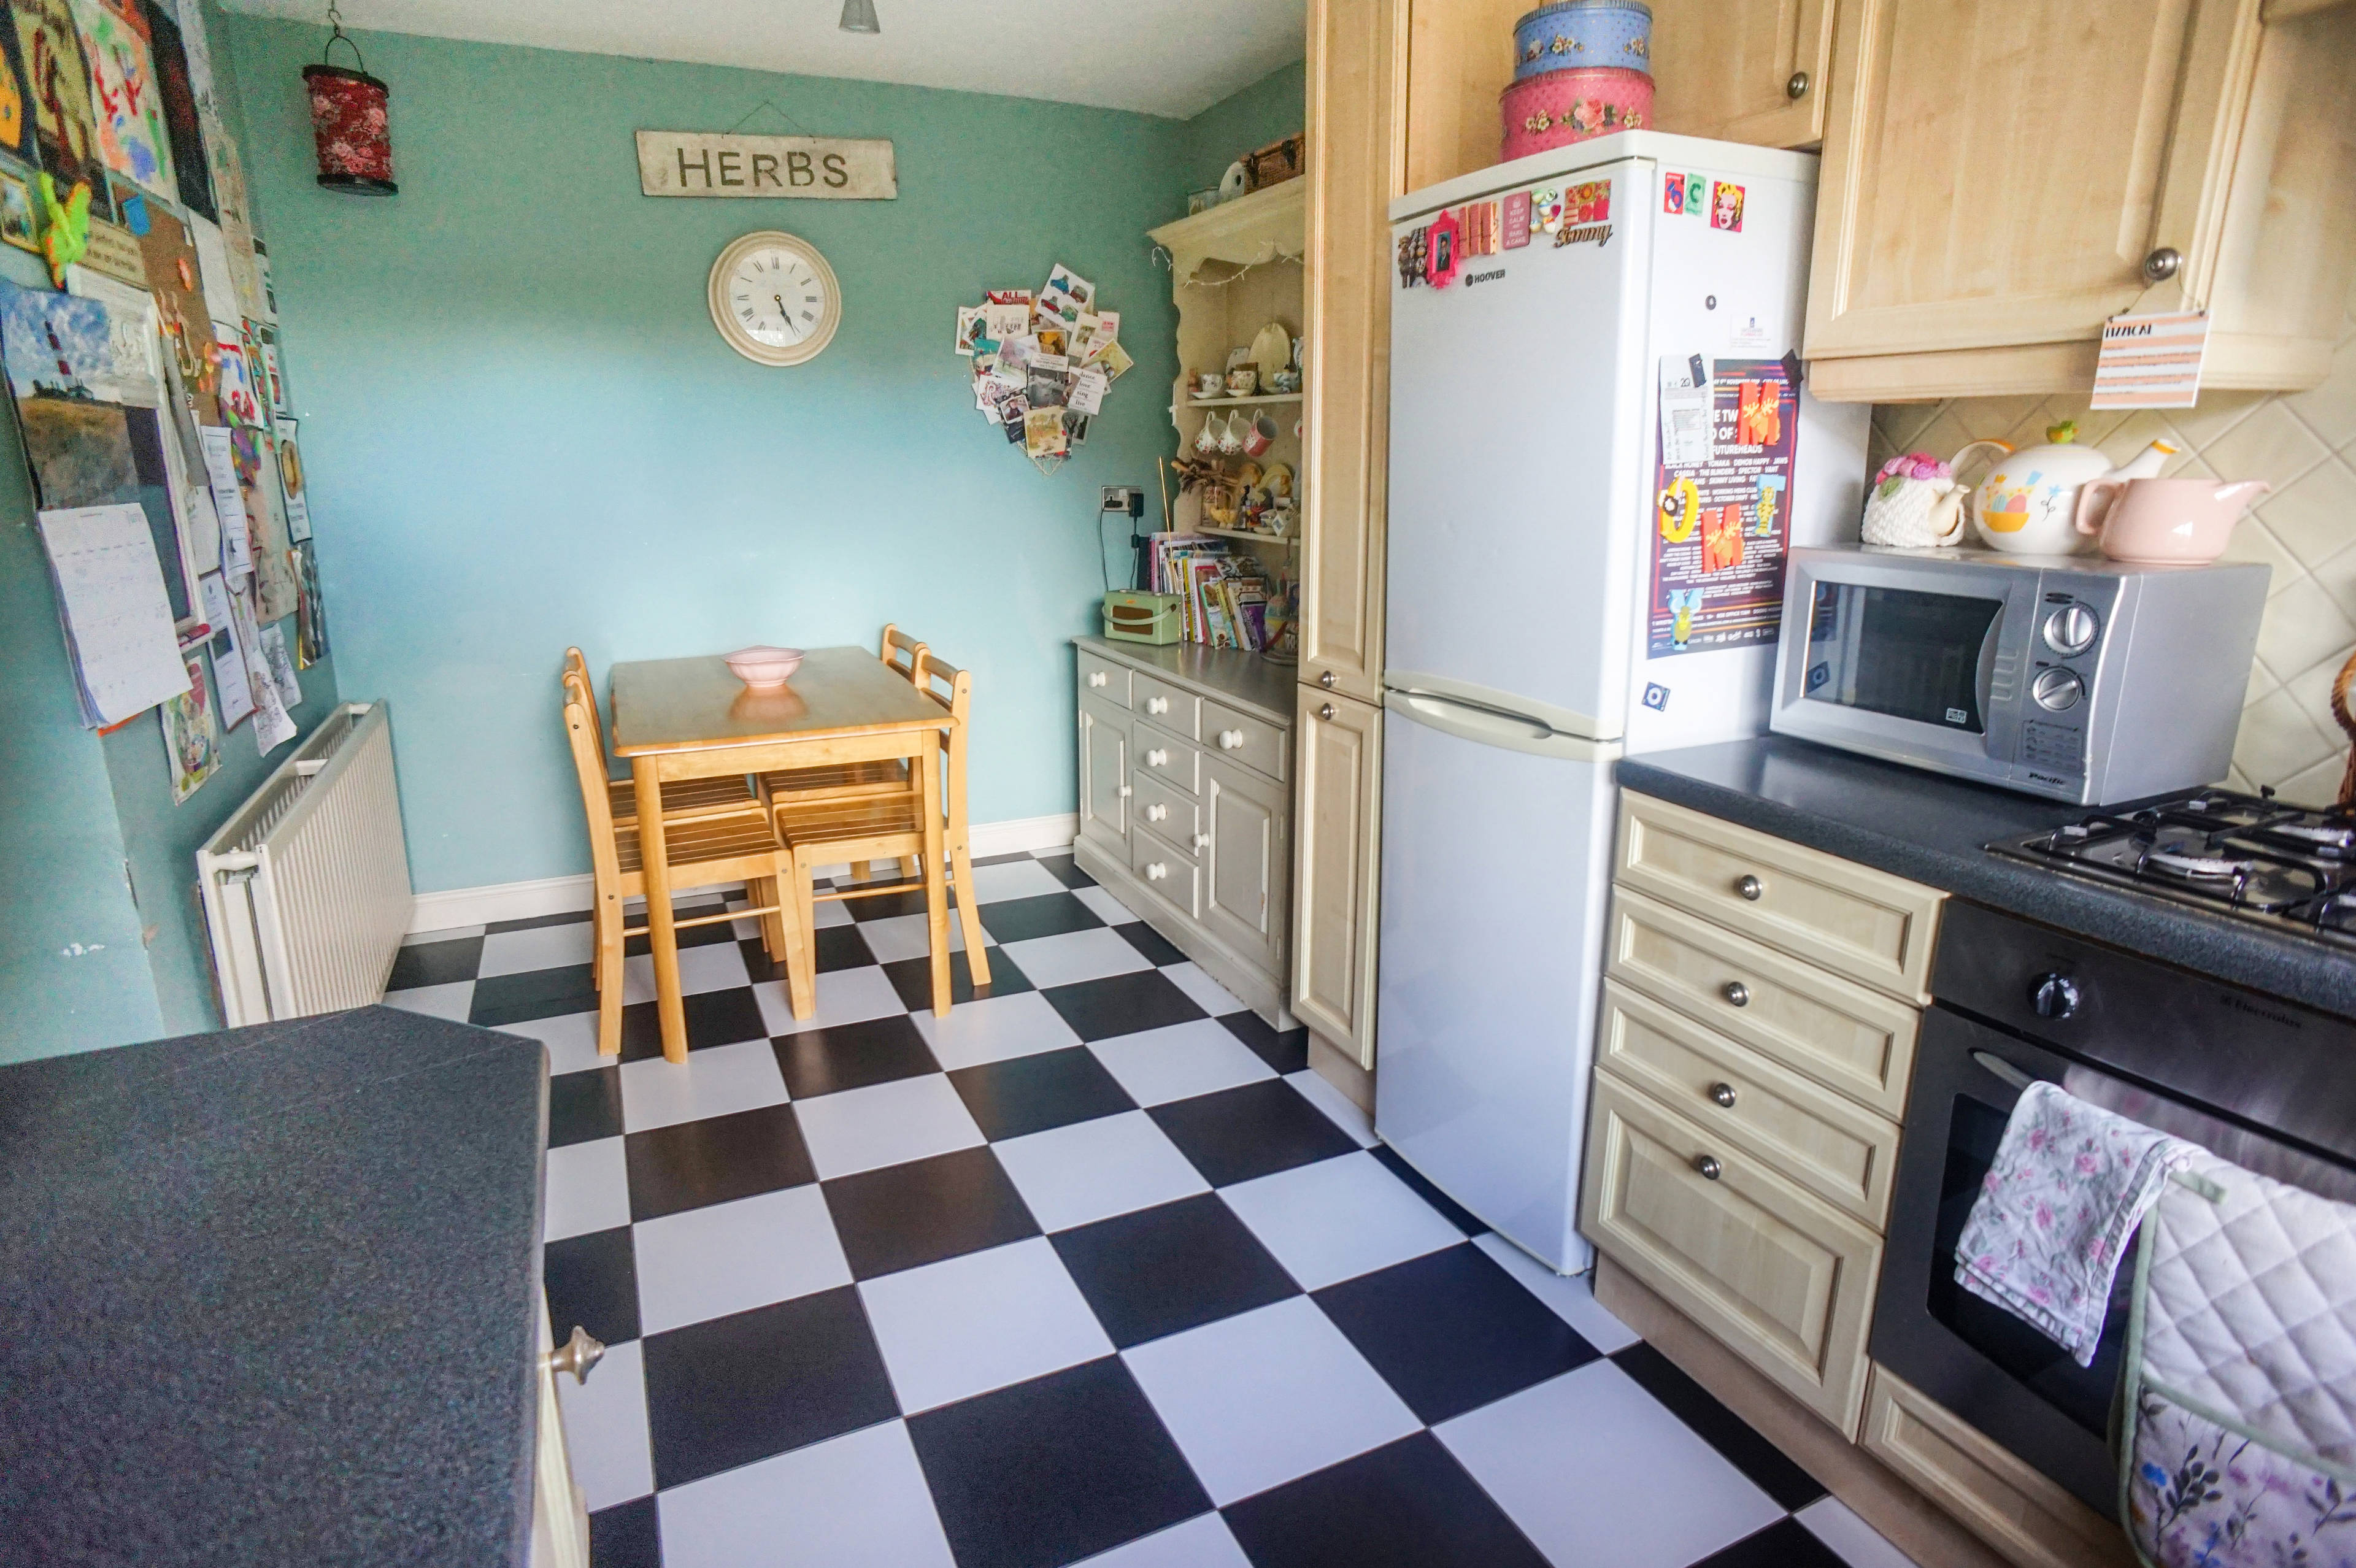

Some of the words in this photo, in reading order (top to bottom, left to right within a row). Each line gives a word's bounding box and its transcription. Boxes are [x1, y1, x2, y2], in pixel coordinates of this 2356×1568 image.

[677, 148, 848, 188] HERBS
[1474, 269, 1506, 283] HOOVER
[1080, 371, 1096, 380] dance
[1712, 444, 1763, 455] FUTUREHEADS
[2029, 772, 2066, 786] Pacific
